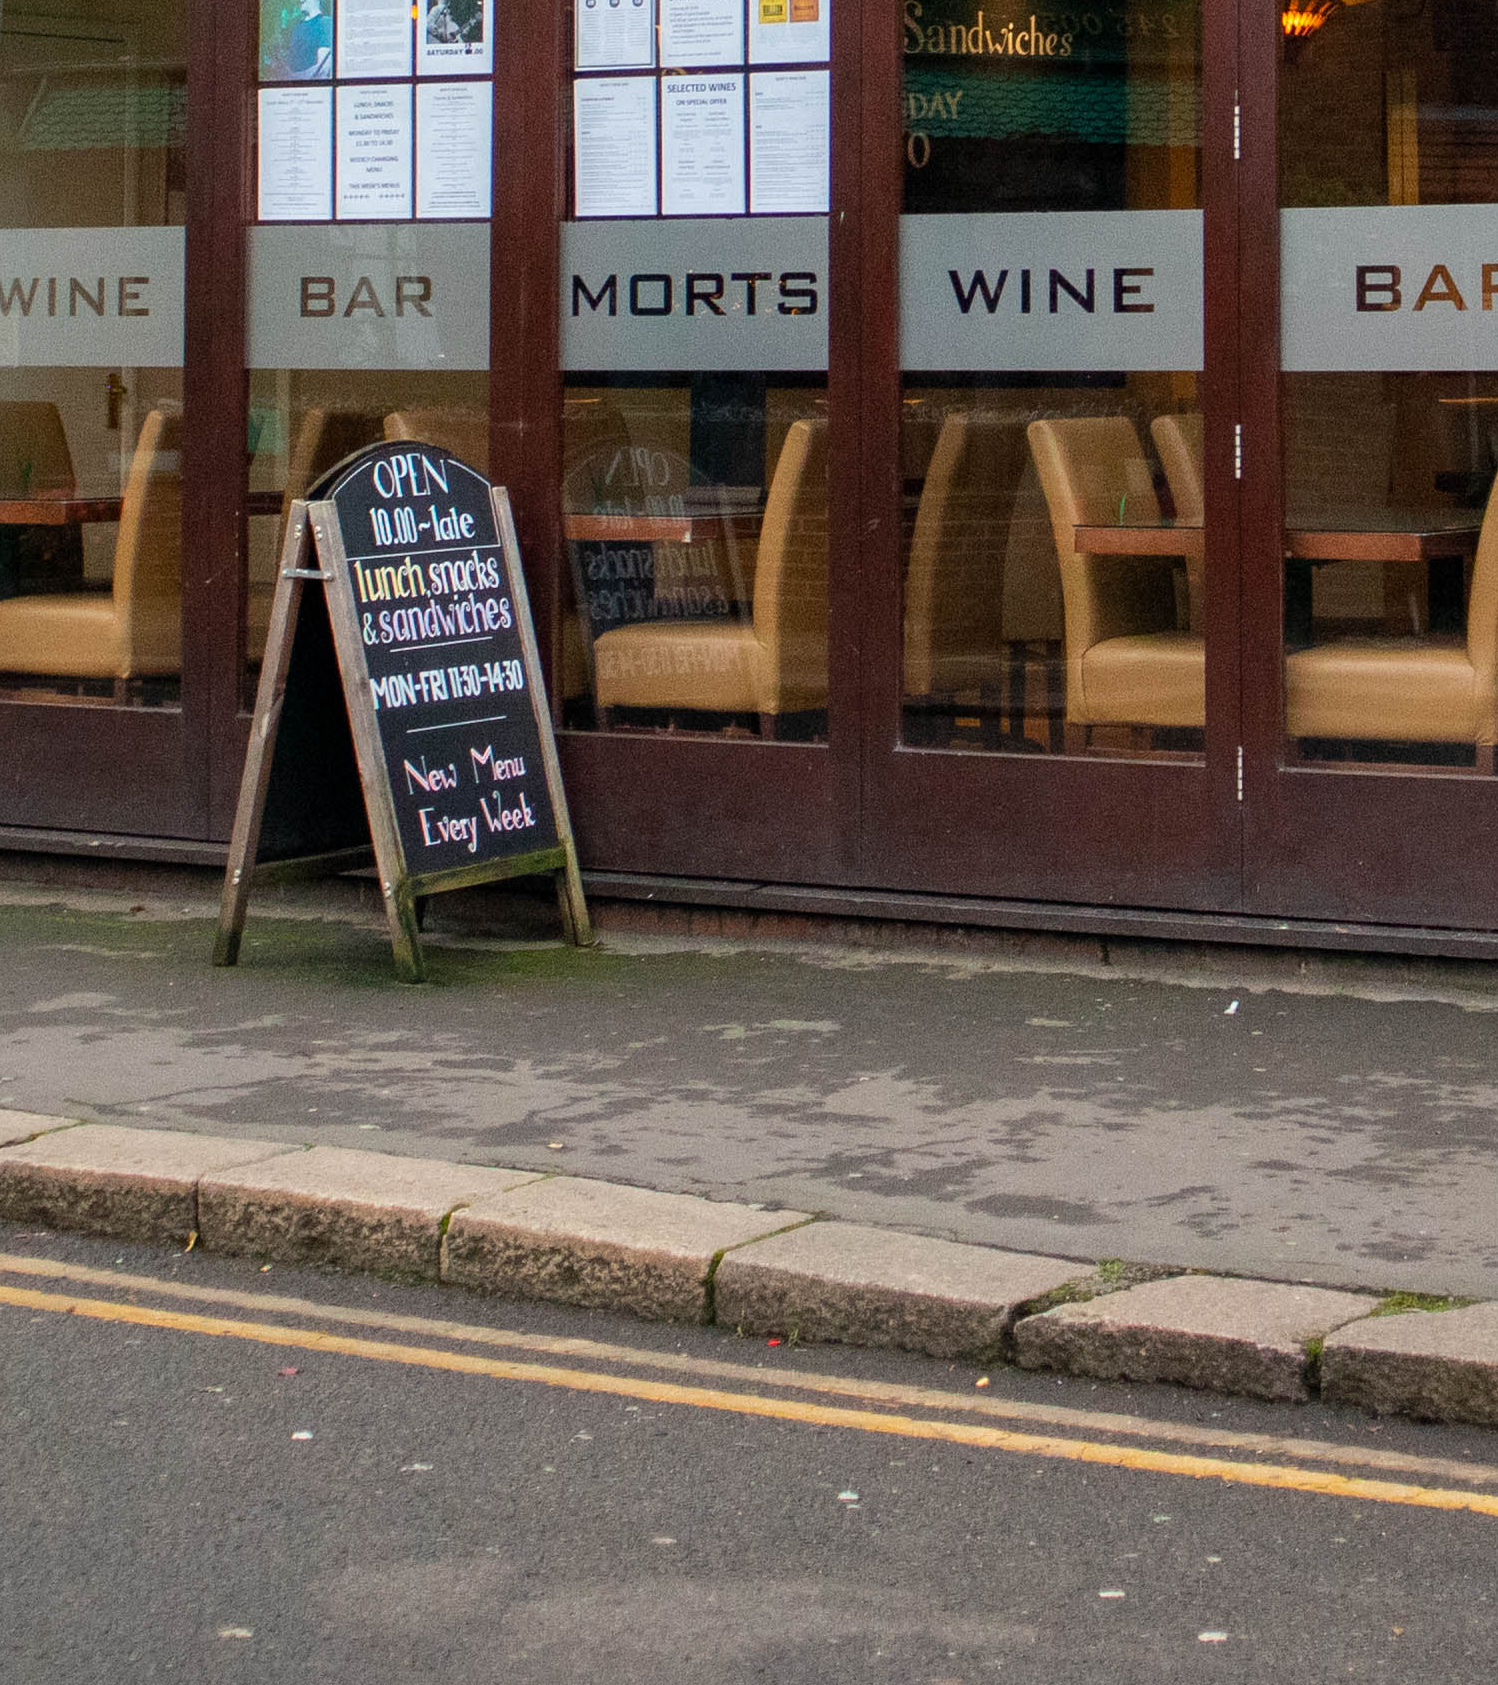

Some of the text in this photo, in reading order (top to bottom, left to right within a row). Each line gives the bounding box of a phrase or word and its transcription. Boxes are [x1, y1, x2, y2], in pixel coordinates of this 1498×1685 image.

[426, 47, 463, 57] SATURDAY
[903, 0, 1073, 56] Sandwiches
[667, 82, 736, 94] SELECTED WINES
[300, 275, 434, 318] BAR
[571, 272, 819, 317] MORTS
[948, 267, 1155, 314] WINE
[373, 452, 449, 499] OPEN
[369, 668, 449, 711] MON-FRI
[403, 743, 527, 796] New Menu
[417, 789, 537, 854] Every Week
